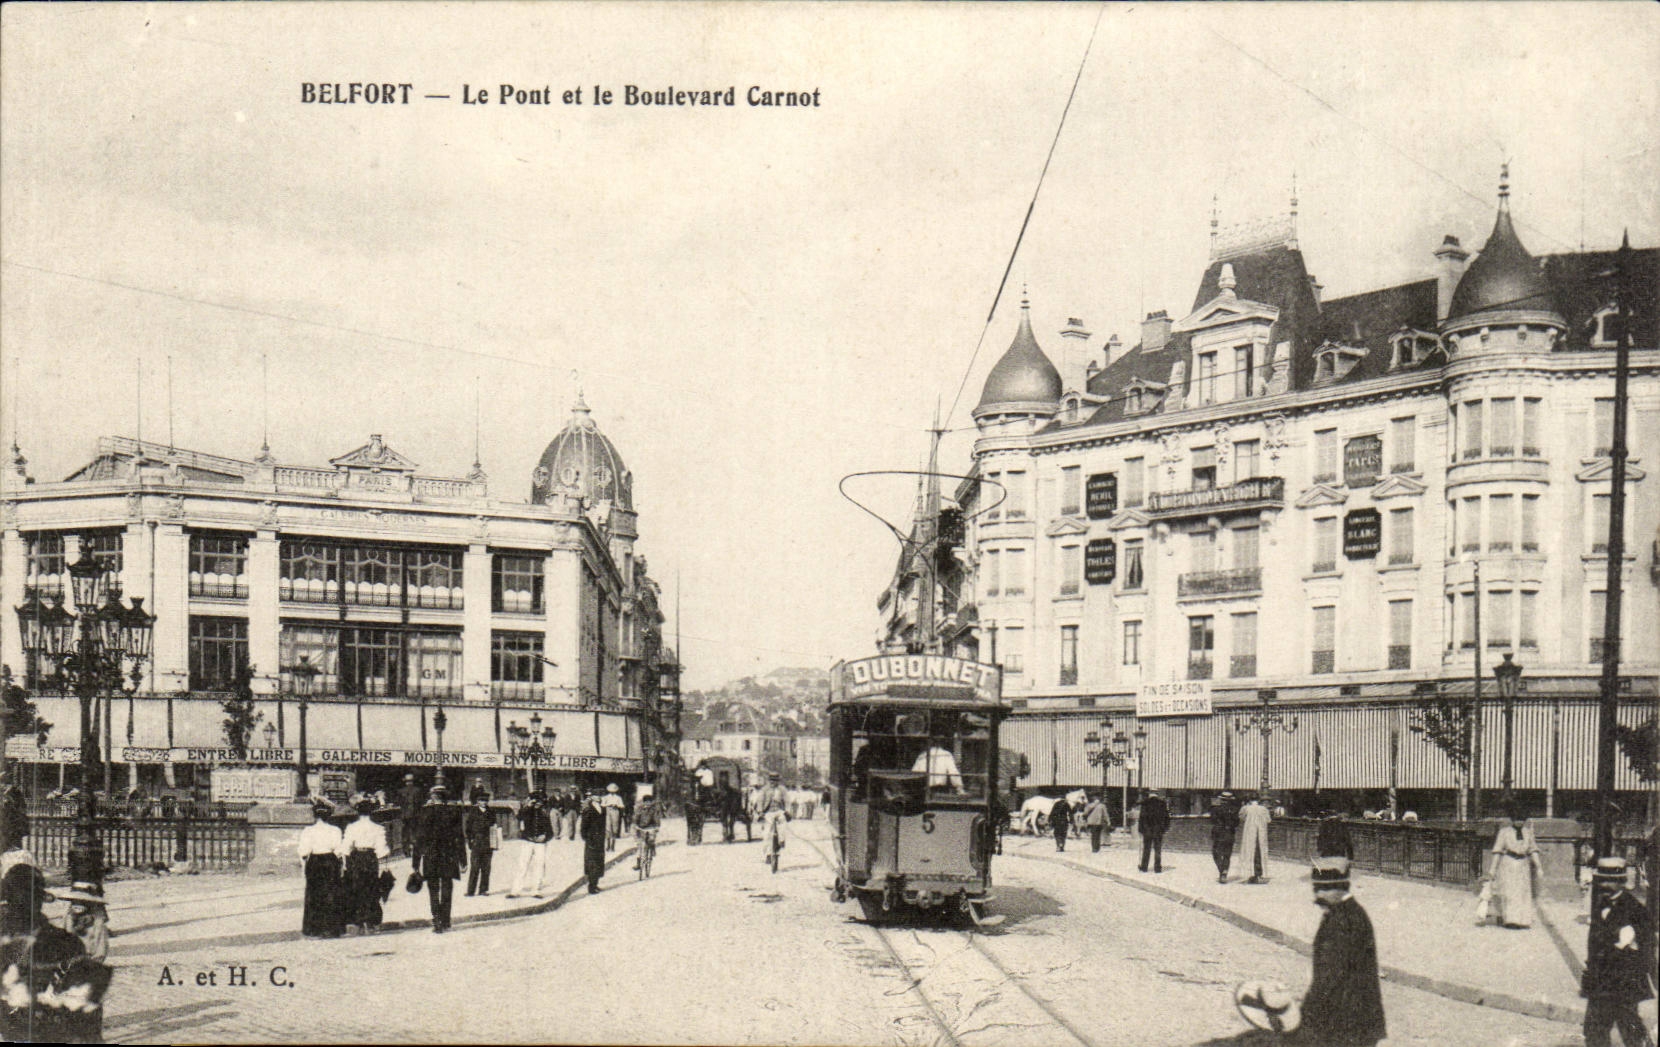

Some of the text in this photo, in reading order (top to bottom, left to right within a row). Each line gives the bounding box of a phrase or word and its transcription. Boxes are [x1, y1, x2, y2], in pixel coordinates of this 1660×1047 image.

[851, 655, 996, 688] DUBONNET
[1143, 683, 1204, 696] FIN DE SAISON
[1139, 701, 1164, 714] SOLDES
[1172, 699, 1209, 712] OCCASIONS
[187, 749, 294, 761] ENTRE LIBRE
[321, 750, 478, 764] GALERIES MODERNES
[559, 756, 598, 769] LIBRE
[921, 812, 936, 834] 5
